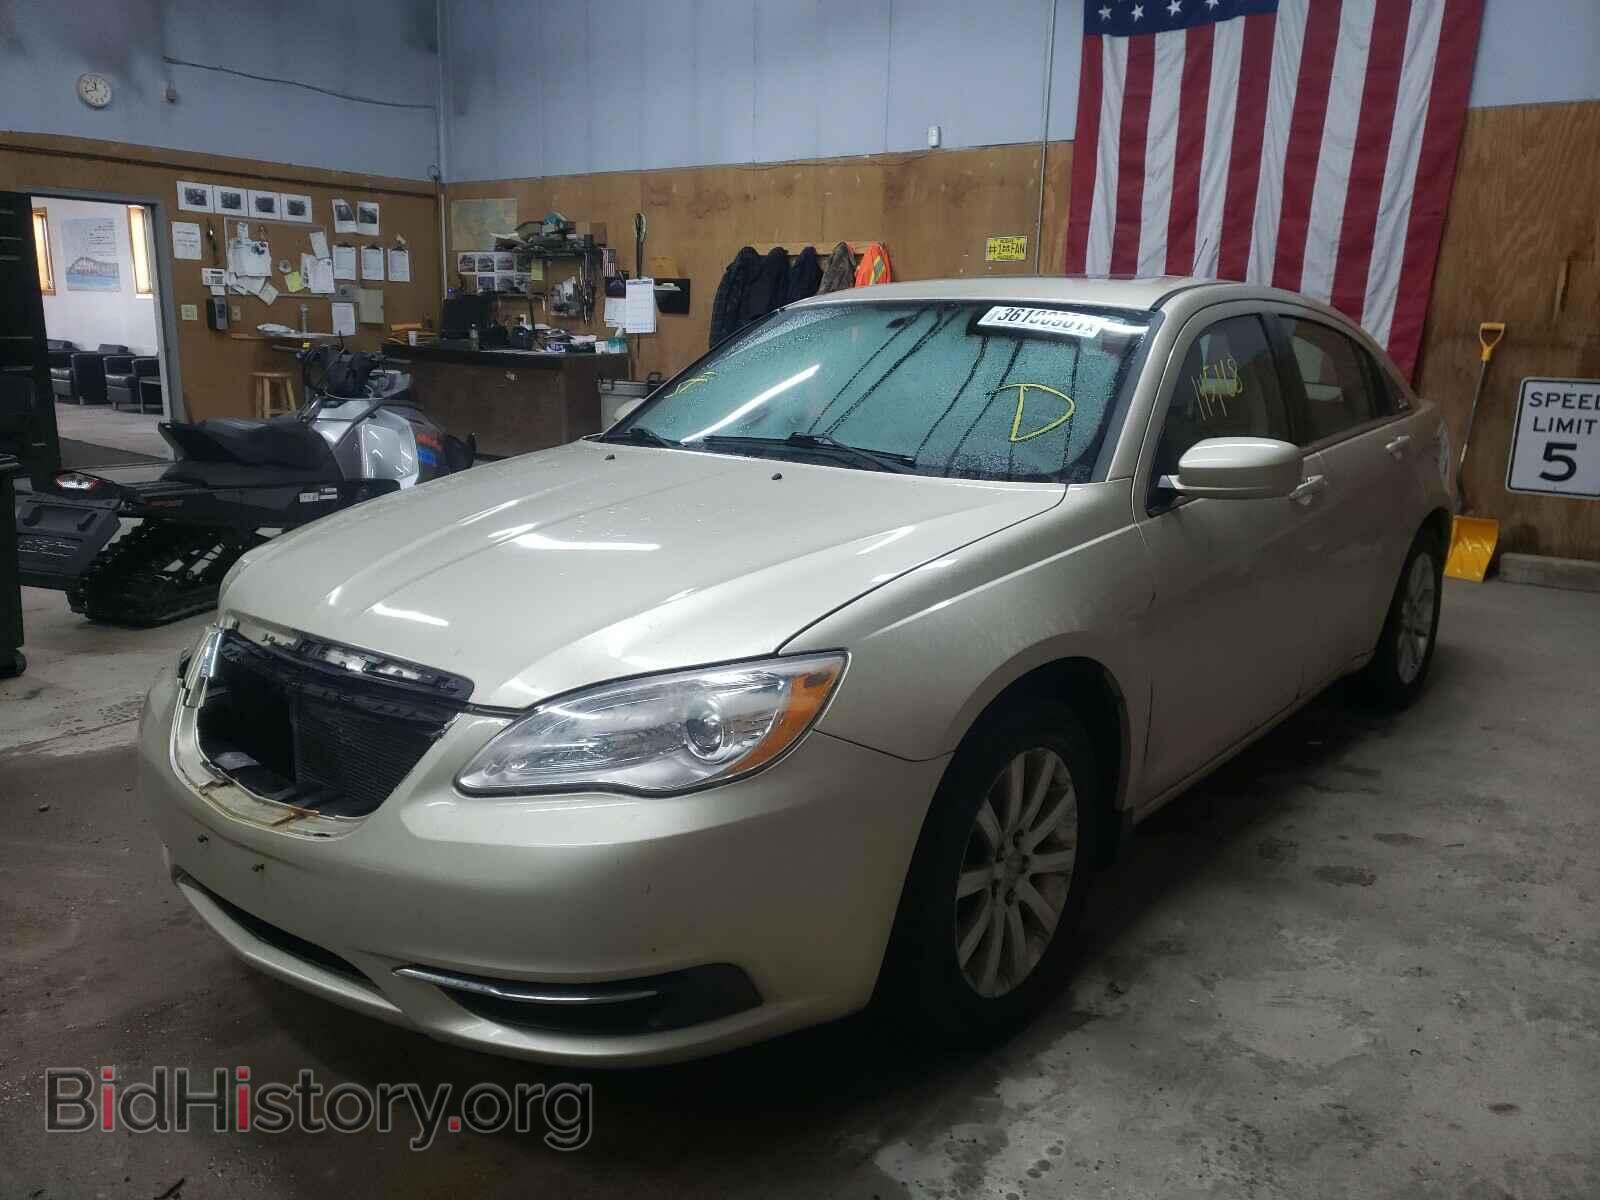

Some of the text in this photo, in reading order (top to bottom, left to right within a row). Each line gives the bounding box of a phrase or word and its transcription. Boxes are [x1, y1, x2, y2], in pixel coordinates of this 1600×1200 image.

[994, 383, 1076, 442] D
[1533, 416, 1598, 435] LIMIT
[1539, 441, 1577, 482] 5
